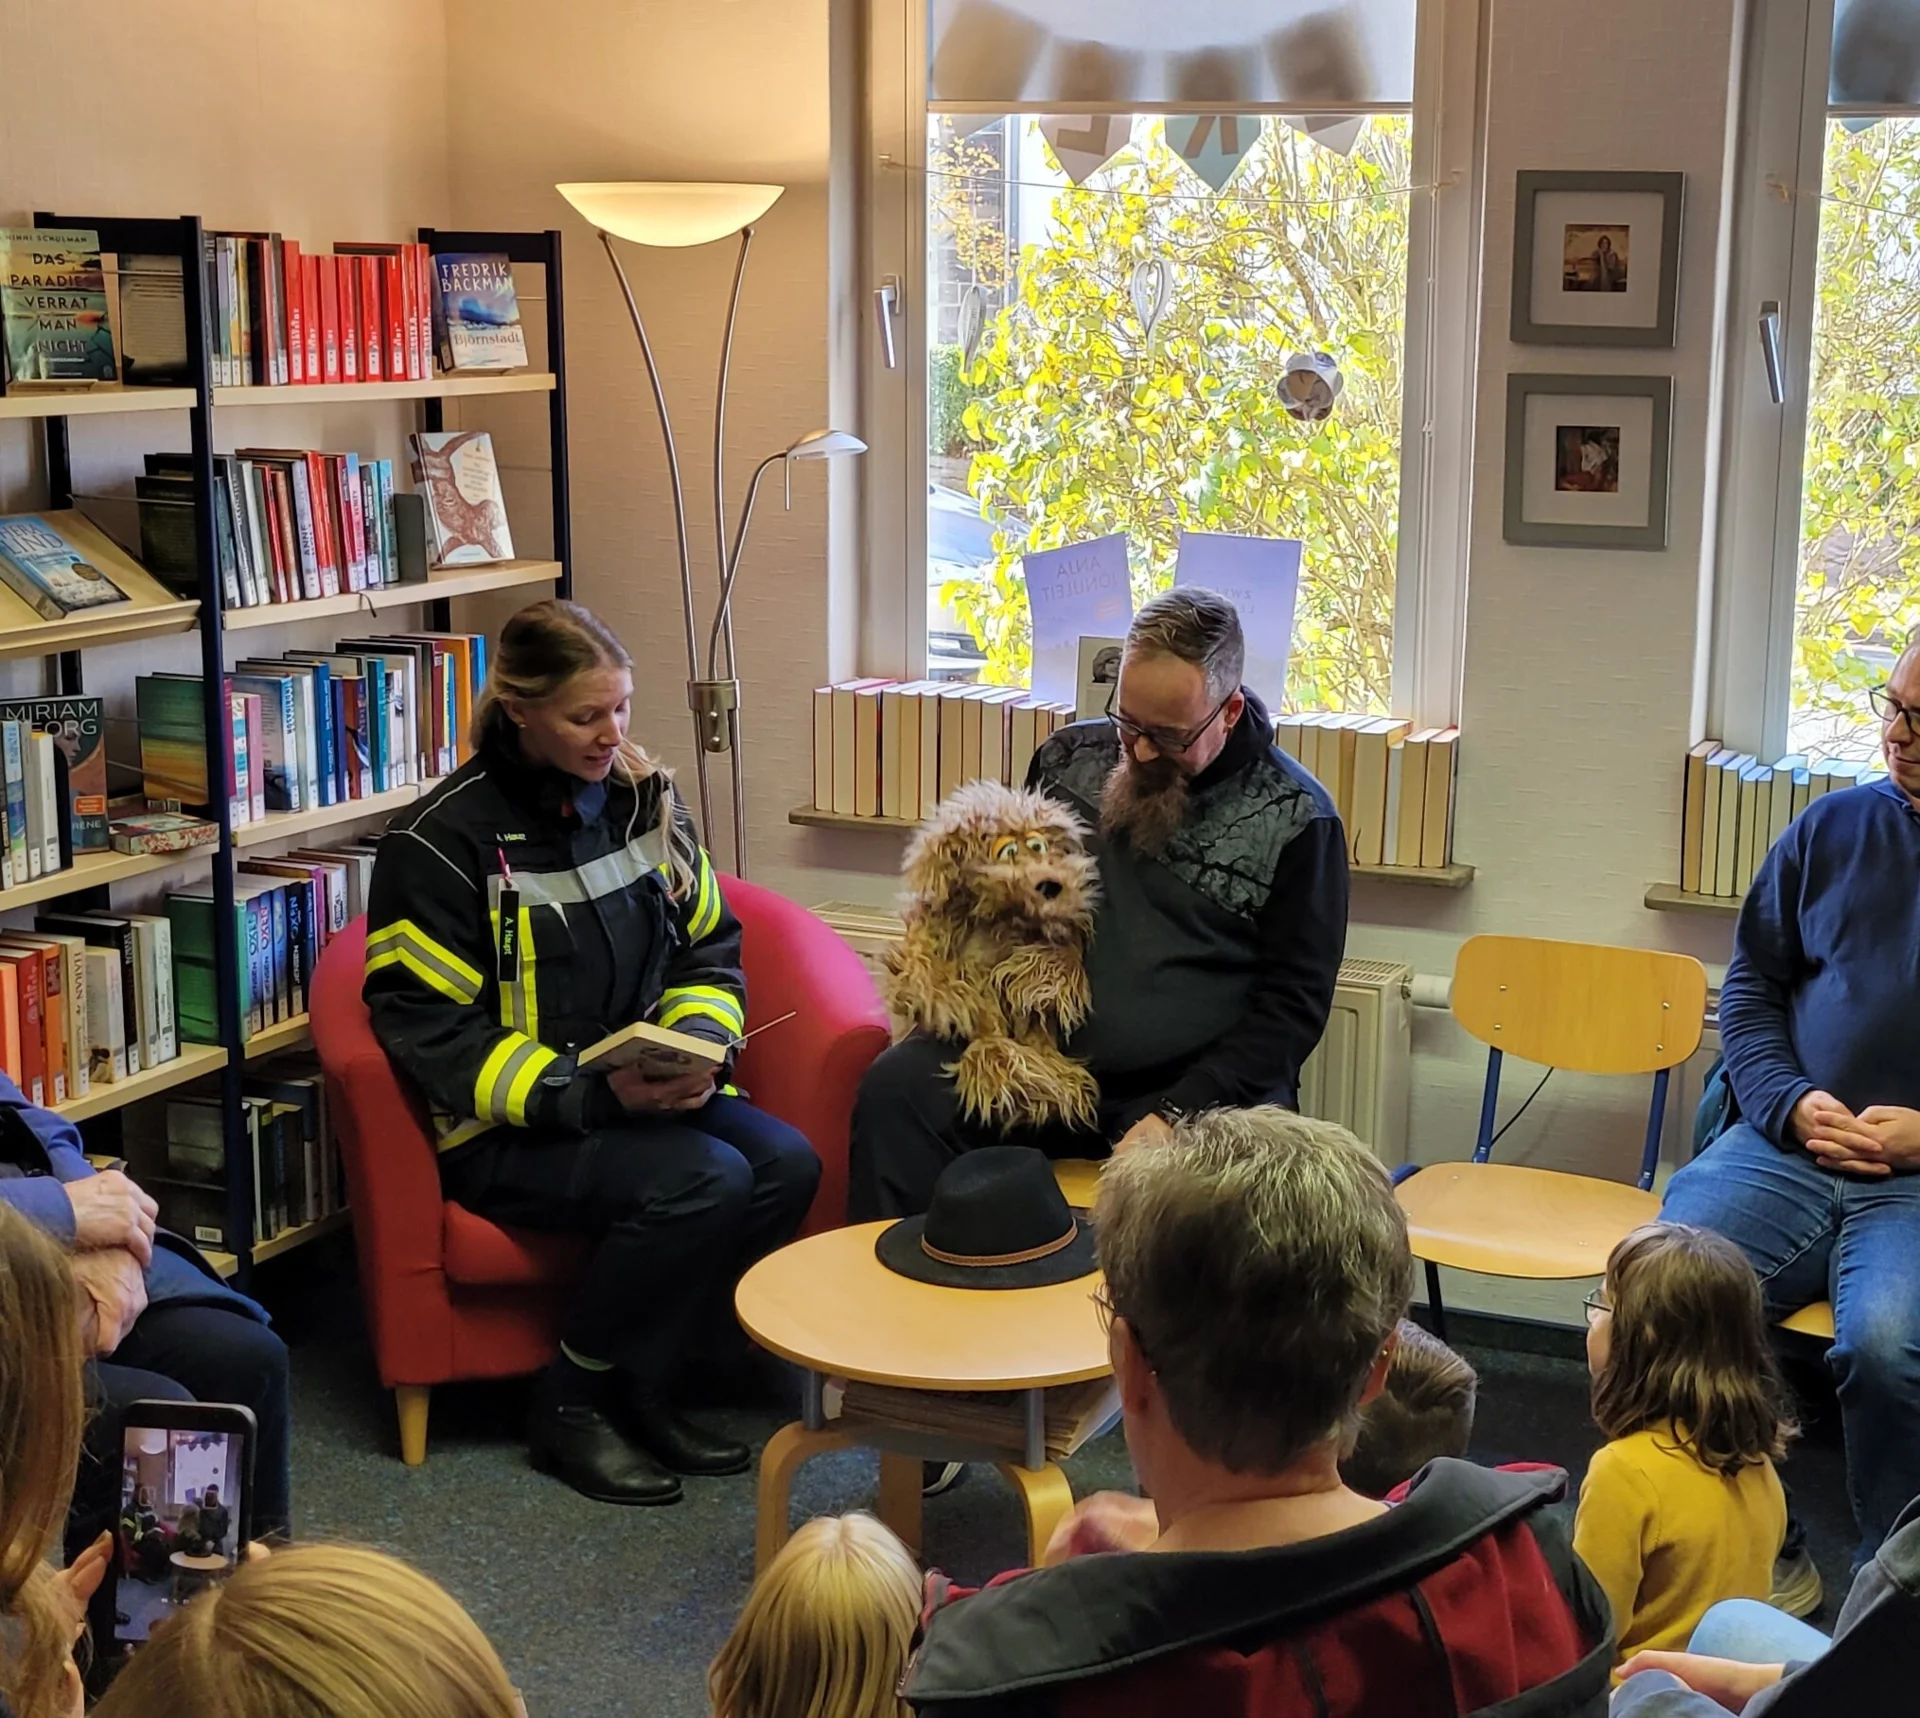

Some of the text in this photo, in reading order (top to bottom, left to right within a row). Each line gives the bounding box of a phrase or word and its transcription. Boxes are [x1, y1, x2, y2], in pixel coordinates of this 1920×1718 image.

[37, 235, 87, 243] SCHULMAN
[33, 253, 66, 265] DAS
[442, 262, 508, 278] FREDRIK
[10, 274, 95, 287] PARADIE
[441, 276, 513, 292] BACKMAN
[24, 296, 88, 309] VERRAT
[38, 319, 77, 331] MAN
[36, 340, 86, 353] NICHT
[0, 523, 43, 539] HERA
[0, 533, 63, 555] LIND
[6, 701, 98, 722] MIRIAM
[32, 718, 97, 738] EORG
